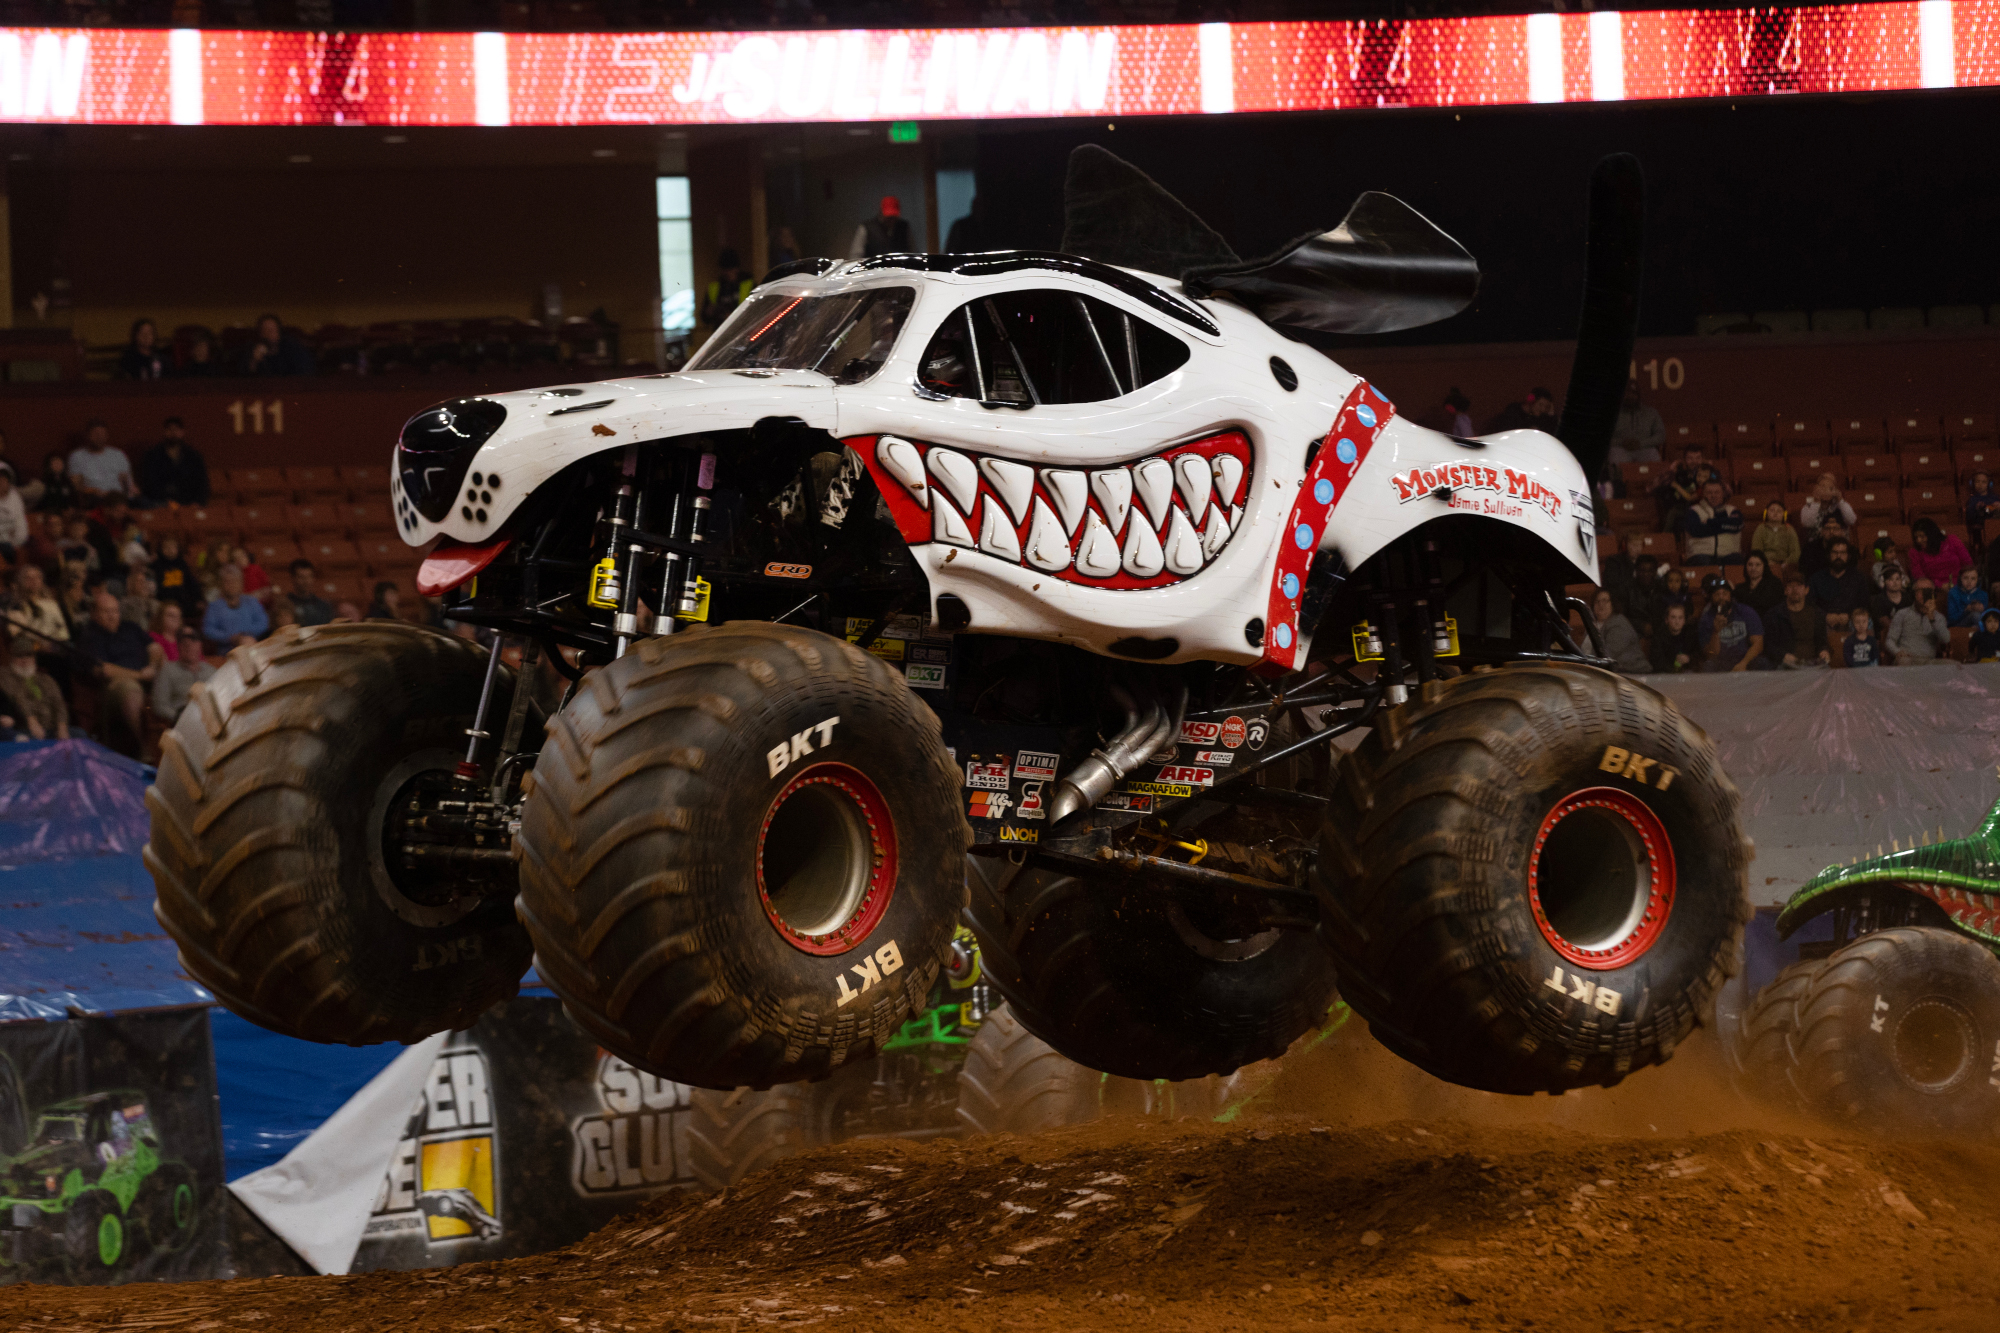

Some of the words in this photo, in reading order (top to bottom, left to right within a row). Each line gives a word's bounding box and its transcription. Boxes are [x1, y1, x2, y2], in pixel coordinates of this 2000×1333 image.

[723, 32, 1116, 118] SULLIVAN
[226, 400, 284, 435] 111
[1390, 464, 1502, 502] MONSTER
[1503, 468, 1562, 519] MUTT
[1447, 493, 1480, 511] Jamie
[1483, 499, 1523, 517] Sullivan
[908, 667, 943, 682] BKT
[1181, 722, 1219, 738] MSD
[1225, 724, 1242, 732] NGK
[766, 716, 840, 779] BKT
[1019, 754, 1056, 769] OPTIMA
[1598, 745, 1682, 792] BKT
[977, 775, 1006, 783] ROD
[1158, 766, 1213, 782] ARP
[969, 780, 1007, 789] ENDS
[1128, 782, 1190, 796] MAGNAFLOW
[1000, 825, 1039, 842] UNOH
[835, 939, 904, 1008] BKT
[1543, 965, 1623, 1016] BKT
